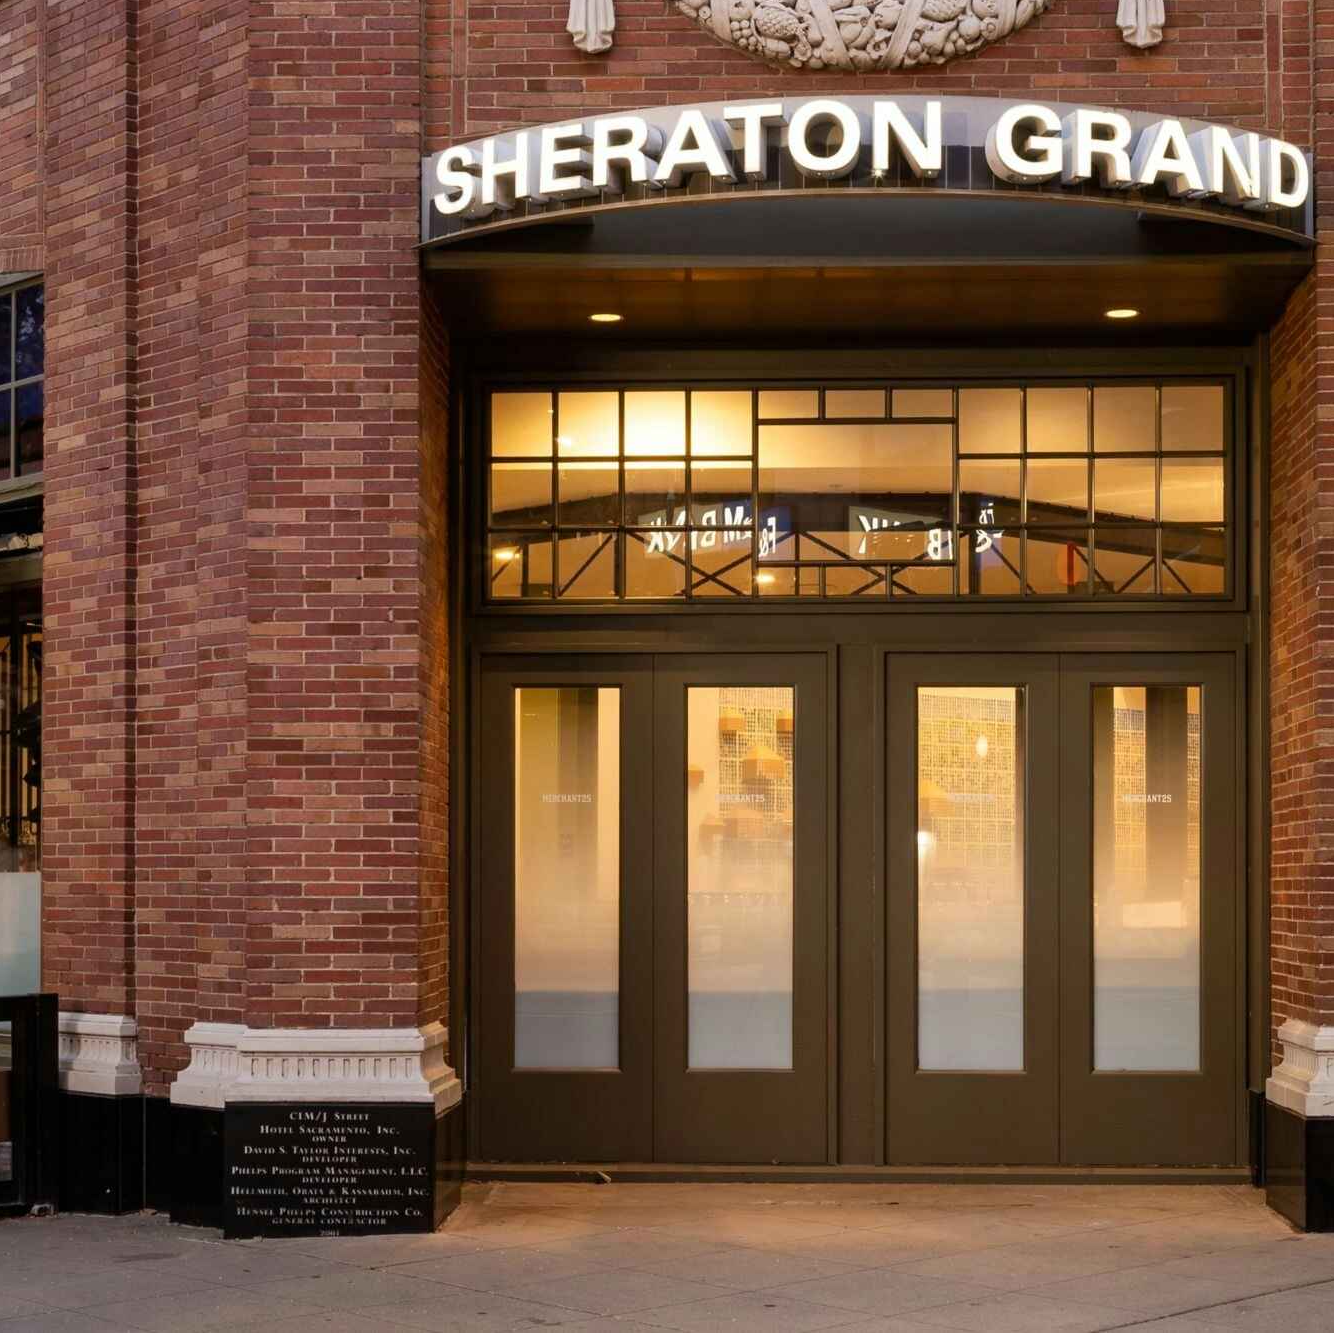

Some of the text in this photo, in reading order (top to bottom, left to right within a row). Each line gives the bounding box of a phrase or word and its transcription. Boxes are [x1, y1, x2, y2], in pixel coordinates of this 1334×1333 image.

[433, 99, 1309, 216] SHERATON GRAND
[542, 794, 592, 803] MERCHANT25
